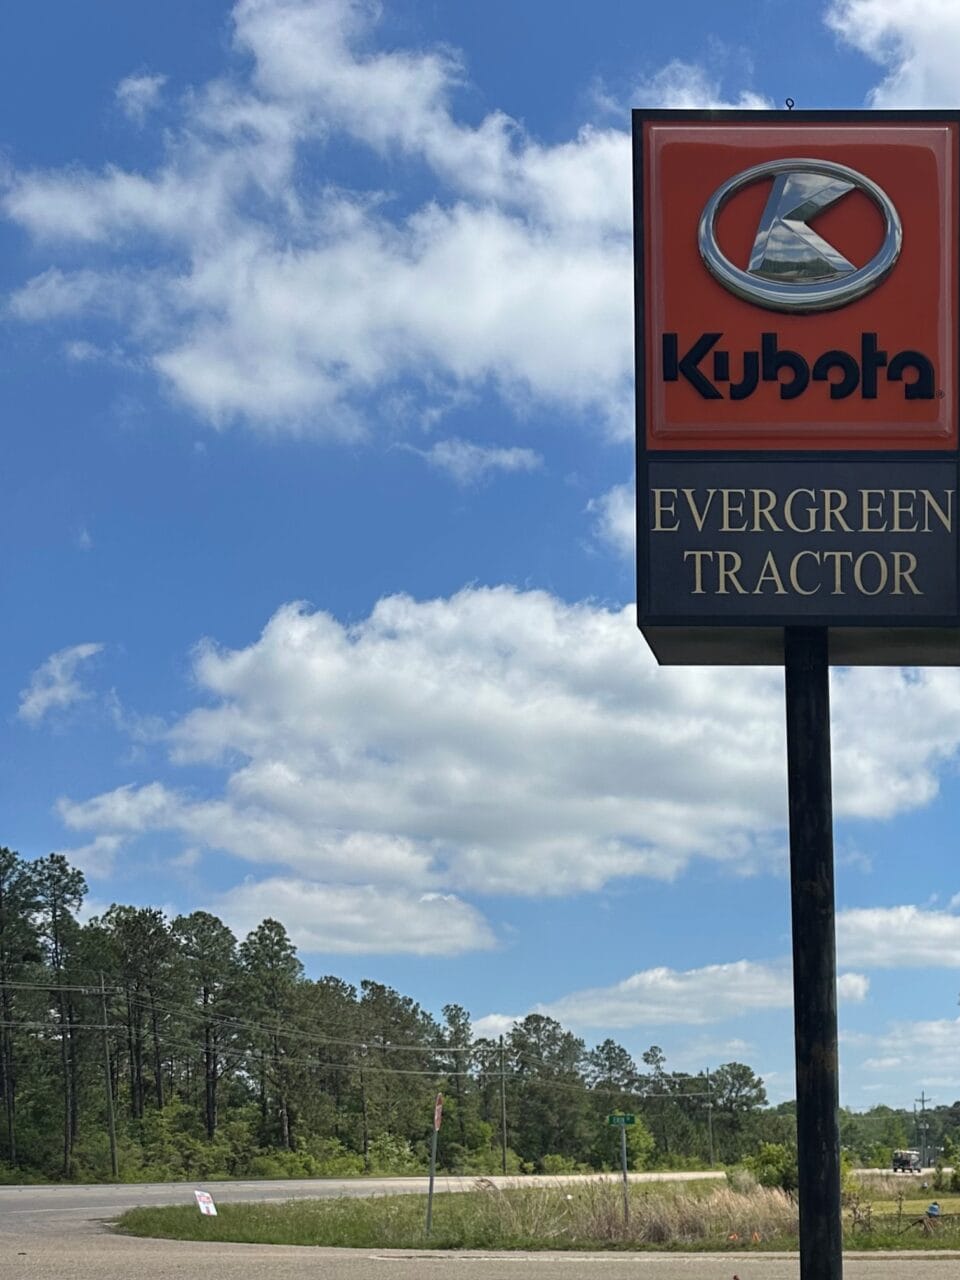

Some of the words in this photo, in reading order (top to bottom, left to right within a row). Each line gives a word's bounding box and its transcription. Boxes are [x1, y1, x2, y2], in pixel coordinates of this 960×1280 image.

[662, 332, 935, 400] Kubota
[651, 488, 955, 533] EVERGREEN
[683, 550, 924, 595] TRACTOR
